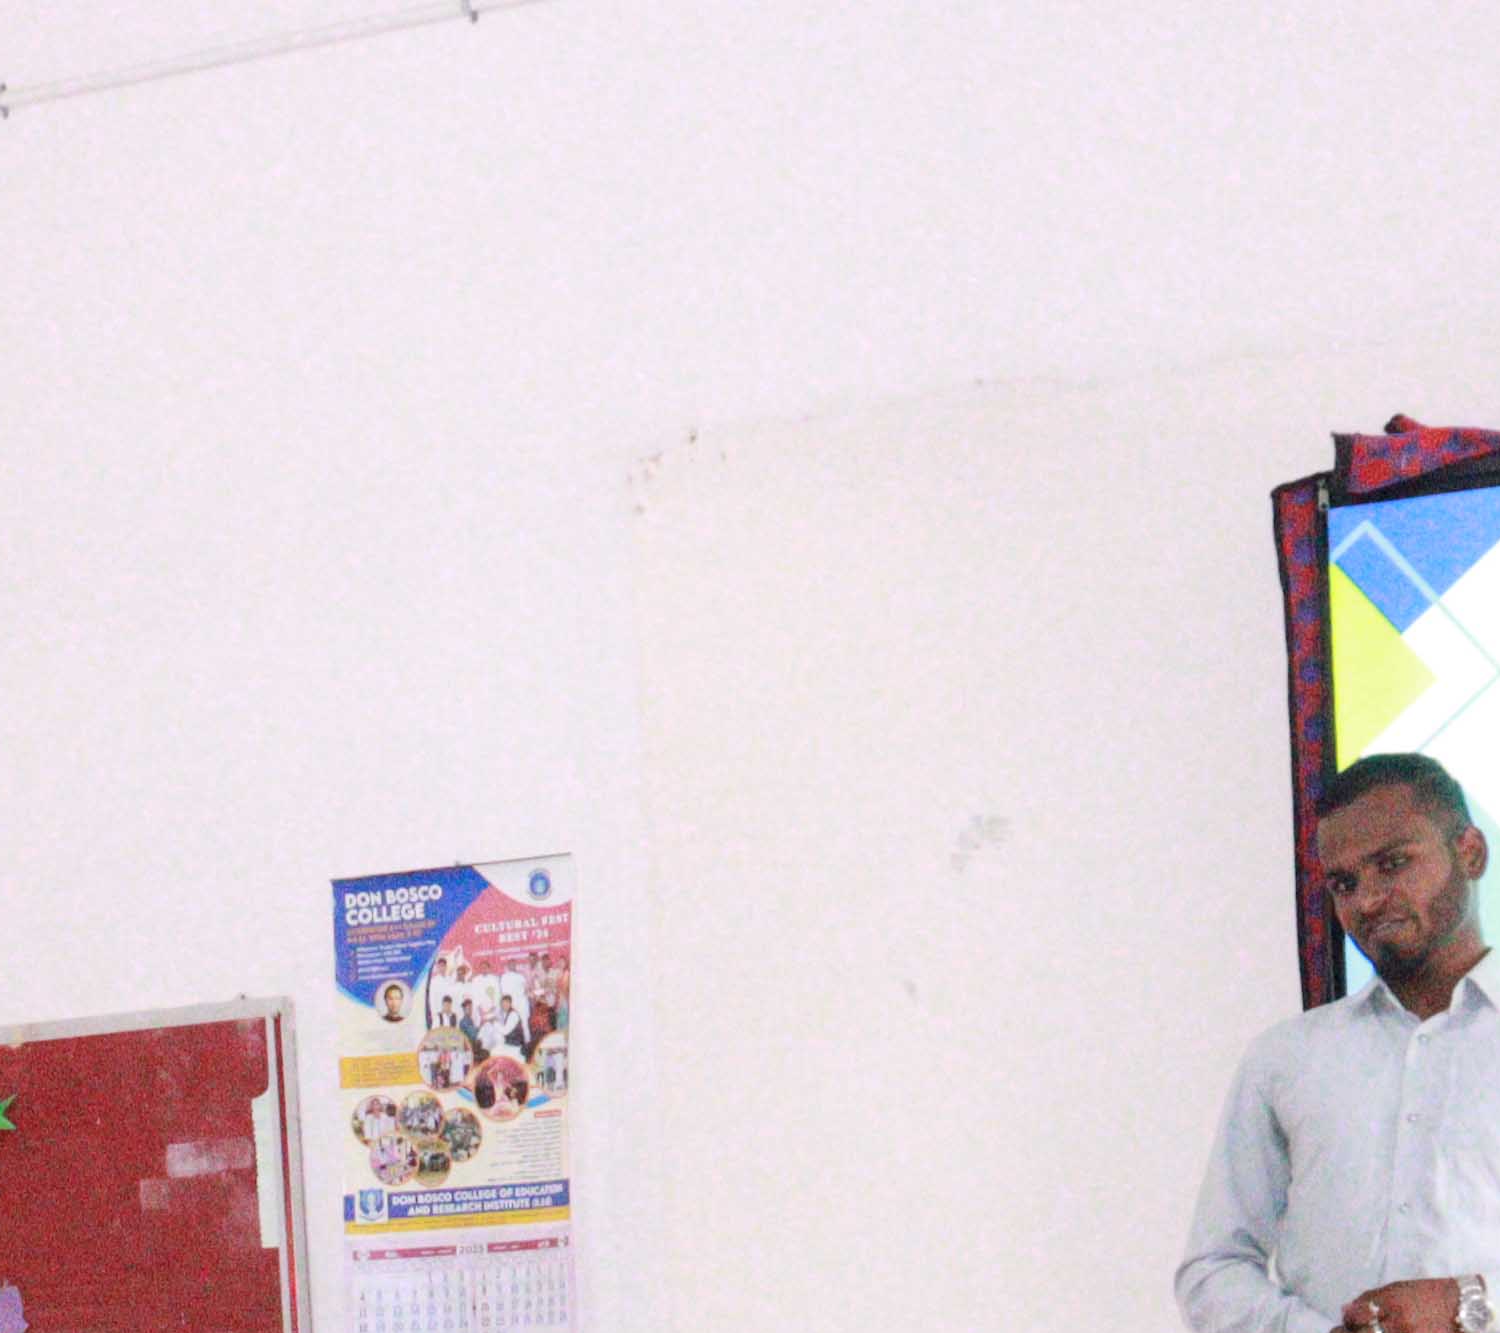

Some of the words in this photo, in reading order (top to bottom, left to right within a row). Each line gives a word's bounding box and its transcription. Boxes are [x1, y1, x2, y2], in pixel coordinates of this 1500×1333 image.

[344, 890, 382, 909] DON
[385, 884, 442, 905] BOSCO
[346, 902, 425, 926] COLLEGE
[454, 1189, 497, 1202] COLLEGE
